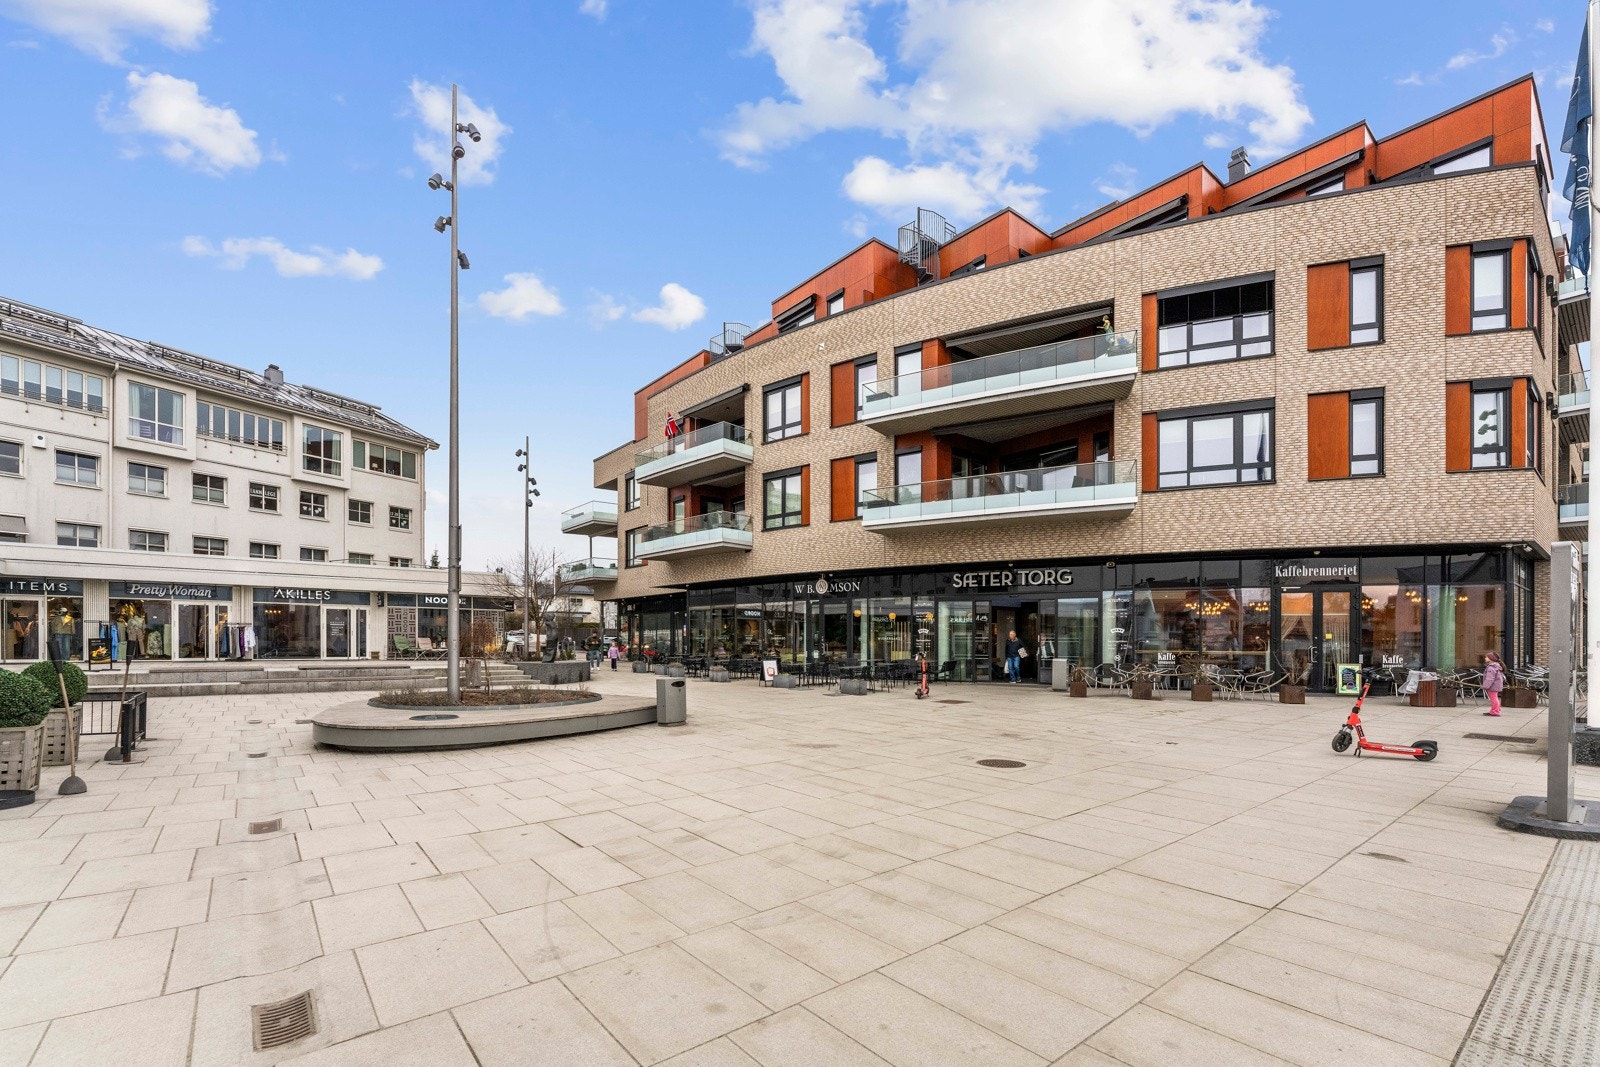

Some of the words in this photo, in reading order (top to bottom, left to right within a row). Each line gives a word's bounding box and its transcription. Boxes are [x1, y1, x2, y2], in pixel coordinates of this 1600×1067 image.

[1275, 564, 1357, 577] Kaffebrenneriet
[952, 571, 1013, 588] SÆTER
[1017, 568, 1072, 586] TORG
[9, 581, 68, 592] ITEMS
[130, 583, 167, 597] Pretty
[168, 585, 212, 598] Woman
[274, 588, 331, 600] AKILLES
[1158, 652, 1176, 661] Kaffe
[1382, 654, 1404, 664] Kaffe
